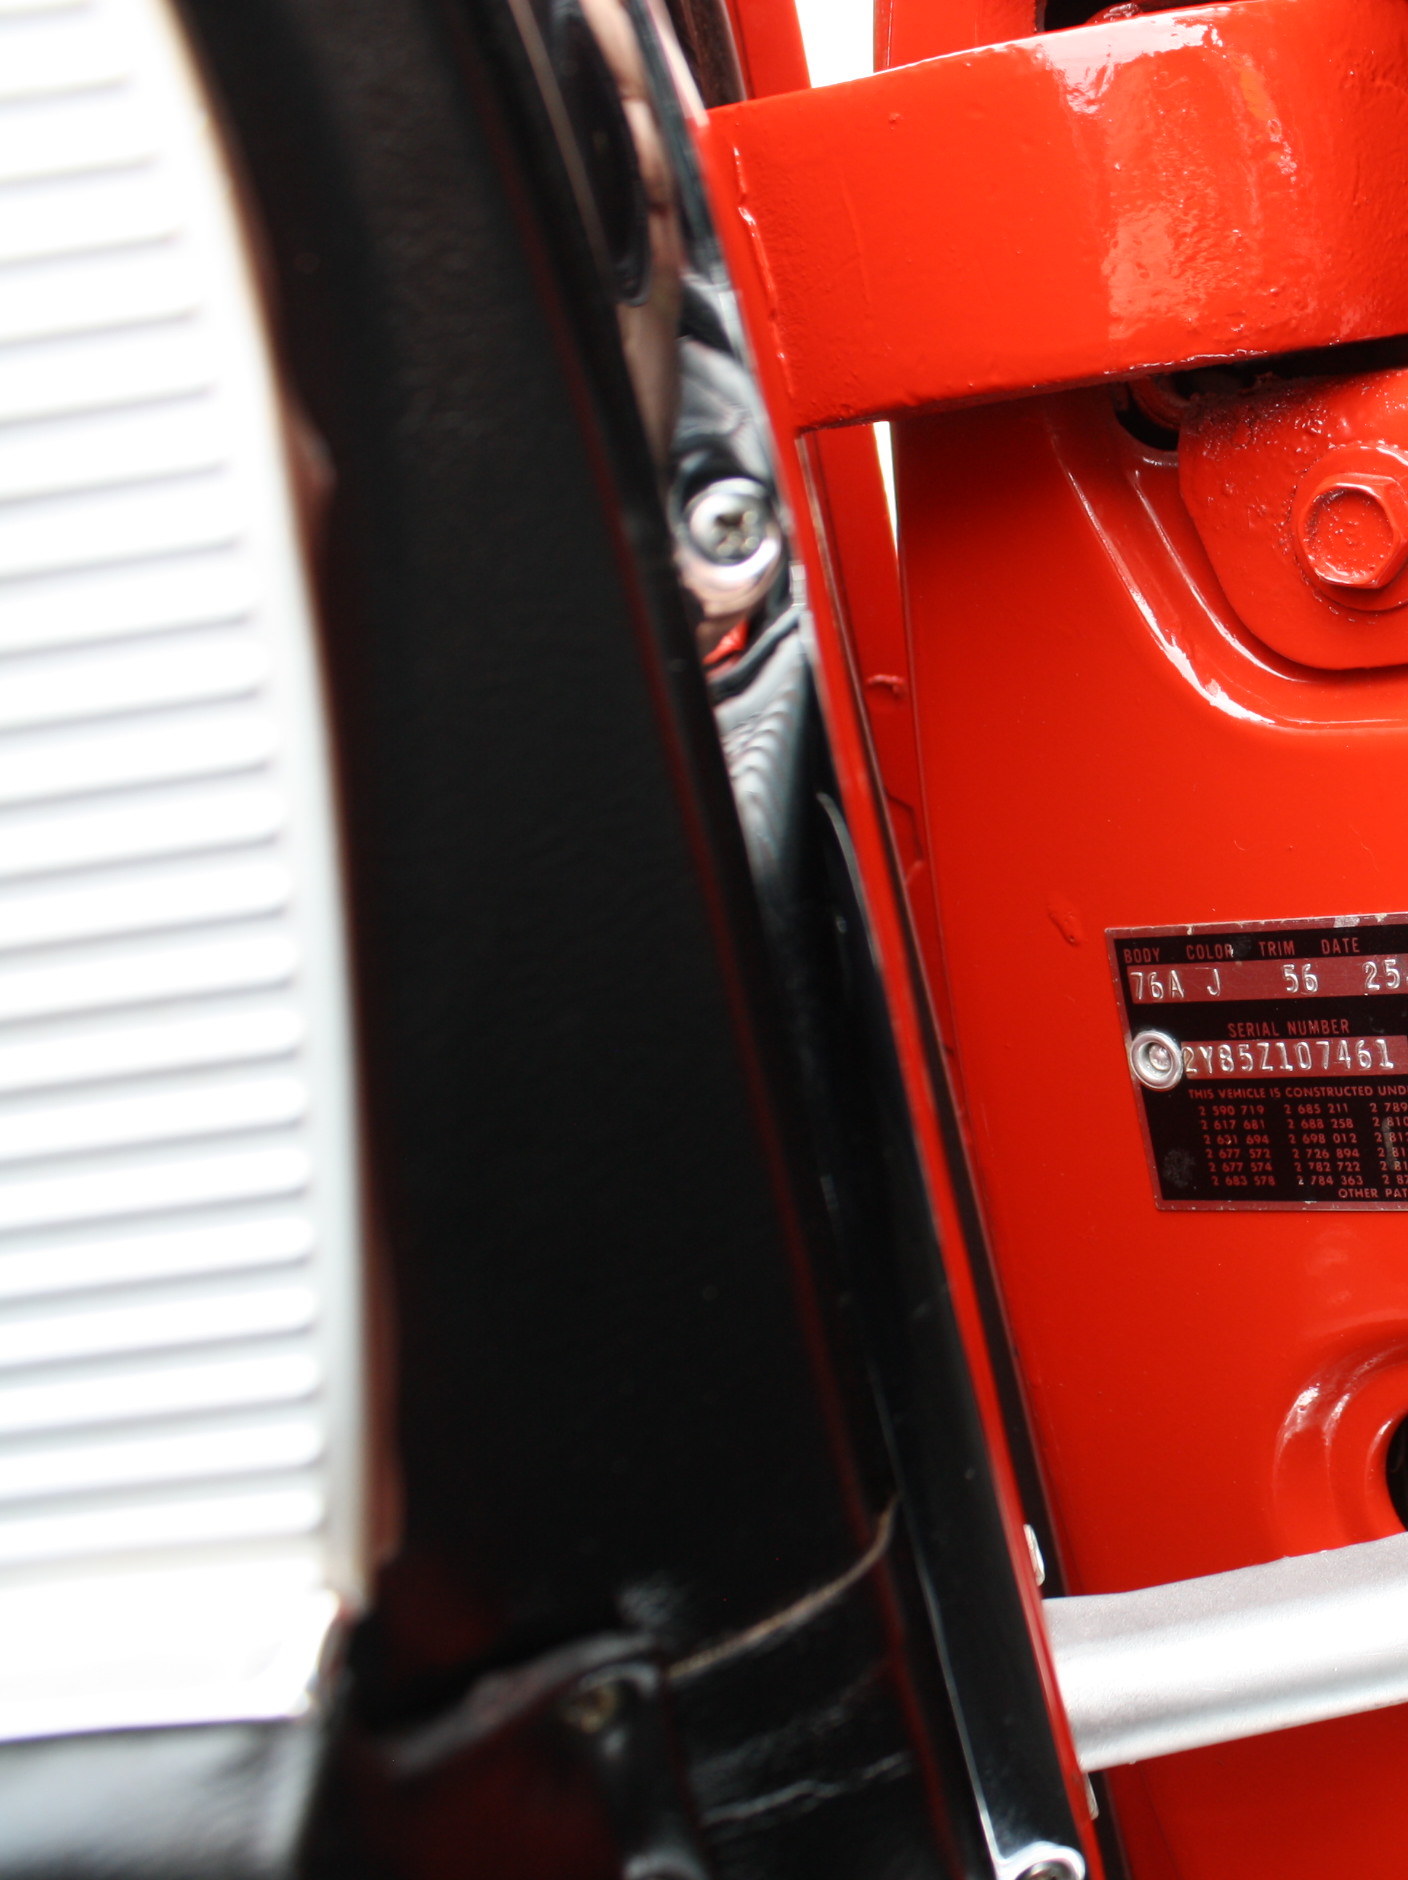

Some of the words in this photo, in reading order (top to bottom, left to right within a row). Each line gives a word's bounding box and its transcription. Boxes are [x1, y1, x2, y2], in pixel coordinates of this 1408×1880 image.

[1124, 948, 1160, 964] BODY
[1186, 944, 1233, 960] COLOR
[1258, 941, 1295, 956] TRIM
[1321, 937, 1360, 955] DATE
[1130, 969, 1185, 1000] 76A
[1206, 968, 1221, 997] J
[1282, 963, 1319, 993] 56
[1228, 1022, 1280, 1038] SERIAL
[1287, 1019, 1349, 1035] NUMBER
[1182, 1039, 1395, 1074] 2Y85Z107461
[1188, 1089, 1214, 1099] THIS
[1218, 1088, 1266, 1099] VEHICLE
[1269, 1088, 1280, 1097] IS
[1285, 1086, 1373, 1098] CONSTRUCTED
[1198, 1106, 1206, 1116] 2
[1212, 1105, 1235, 1116] 590
[1241, 1105, 1264, 1115] 719
[1284, 1104, 1292, 1114] 2
[1298, 1104, 1321, 1114] 685
[1328, 1103, 1348, 1114] 211
[1370, 1103, 1378, 1112] 2
[1384, 1102, 1408, 1112] 789
[1200, 1120, 1208, 1129] 2
[1214, 1120, 1236, 1129] 617
[1288, 1119, 1295, 1129] 2
[1331, 1118, 1353, 1128] 258
[1372, 1117, 1380, 1126] 2
[1203, 1135, 1211, 1144] 2
[1246, 1135, 1269, 1145] 694
[1288, 1134, 1296, 1144] 2
[1303, 1134, 1325, 1144] 698
[1333, 1133, 1357, 1143] 012
[1374, 1132, 1382, 1142] 2
[1205, 1149, 1213, 1158] 2
[1219, 1149, 1240, 1158] 677
[1249, 1149, 1271, 1158] 572
[1292, 1149, 1299, 1158] 2
[1306, 1149, 1329, 1158] 726
[1336, 1148, 1359, 1158] 894
[1377, 1148, 1385, 1157] 2
[1208, 1162, 1216, 1172] 2
[1222, 1162, 1243, 1172] 677
[1294, 1162, 1302, 1172] 2
[1308, 1162, 1331, 1172] 782
[1337, 1162, 1360, 1171] 722
[1380, 1161, 1388, 1171] 2
[1212, 1176, 1219, 1186] 2
[1297, 1176, 1304, 1185] 2
[1311, 1176, 1333, 1185] 784
[1341, 1176, 1363, 1185] 363
[1382, 1175, 1390, 1184] 2
[1338, 1188, 1378, 1198] OTHER
